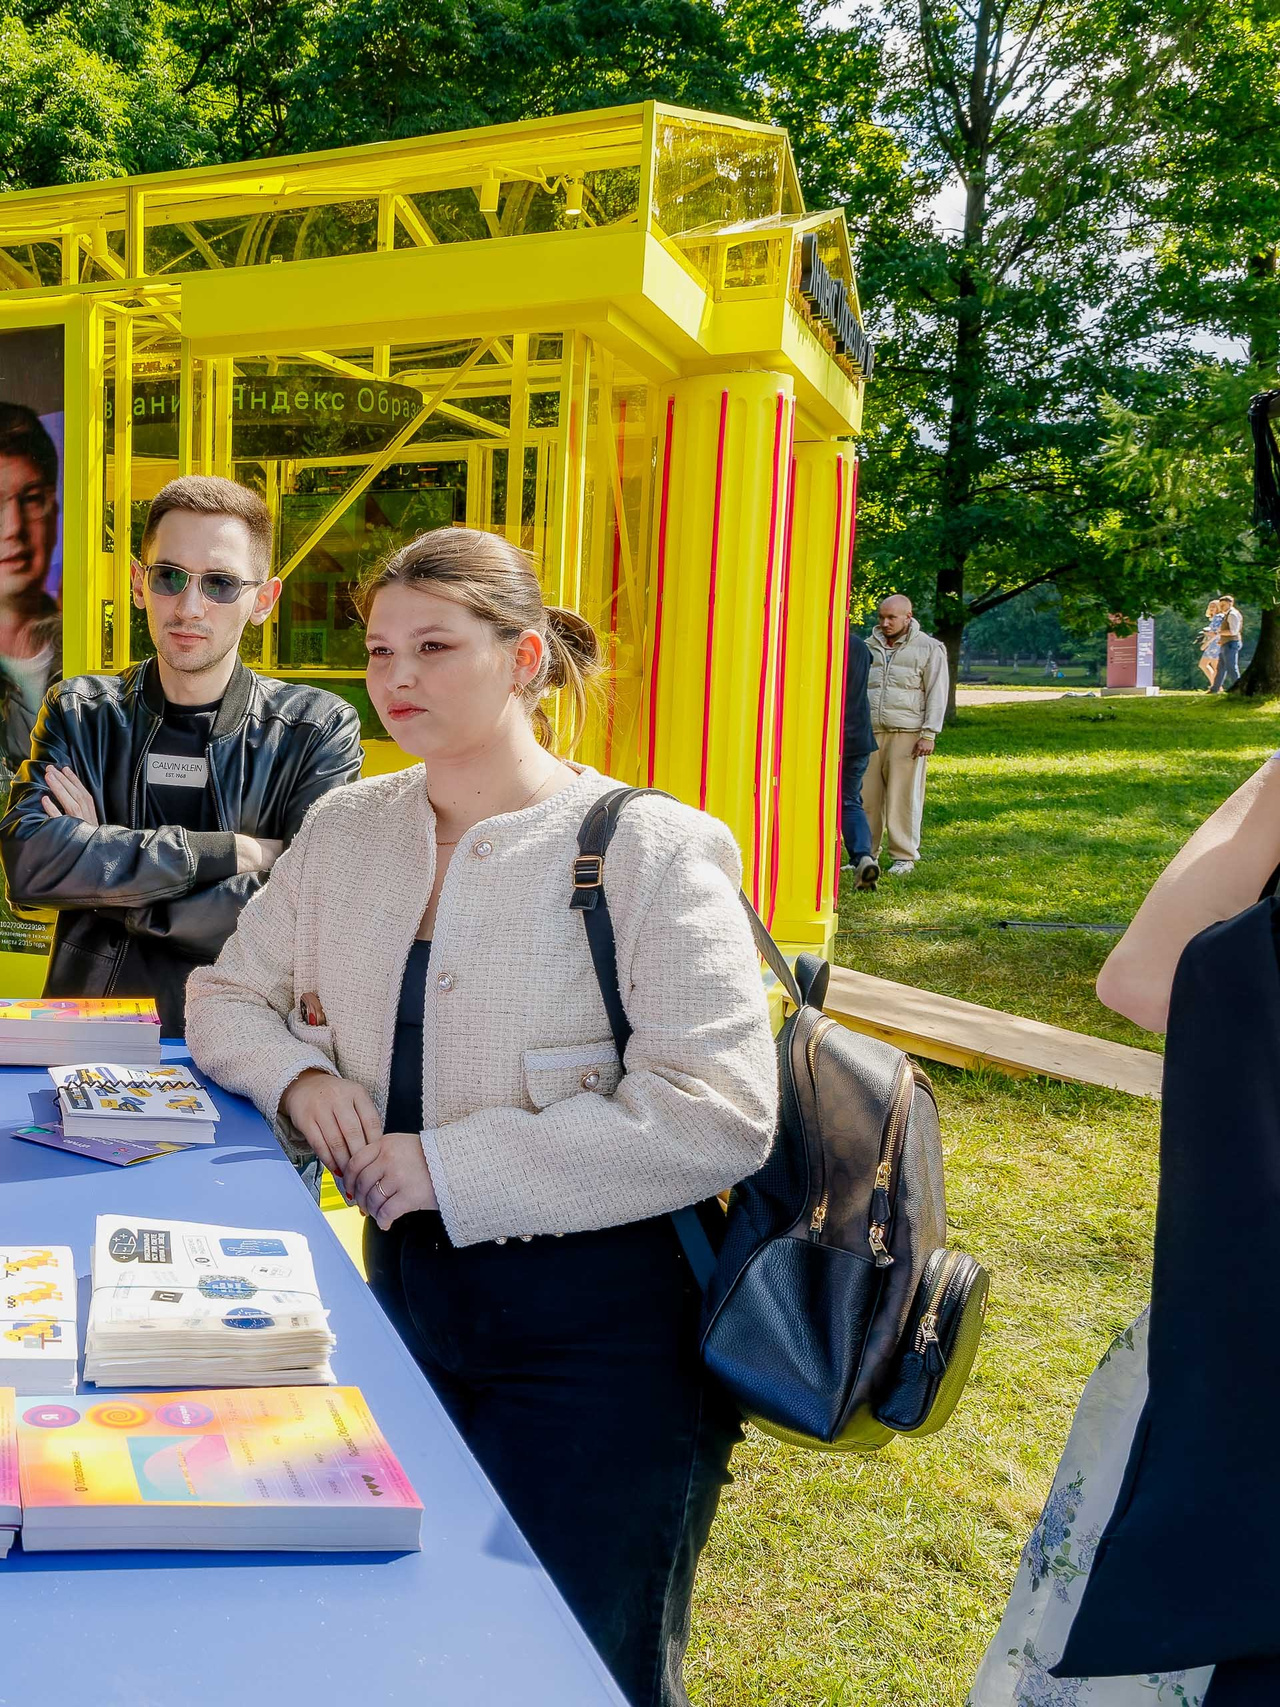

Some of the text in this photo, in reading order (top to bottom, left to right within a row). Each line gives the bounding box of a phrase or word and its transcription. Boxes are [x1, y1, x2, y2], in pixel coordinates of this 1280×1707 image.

[151, 761, 203, 772] CALVIN KLEIN
[40, 1413, 60, 1421] Я
[325, 1398, 361, 1458] Яндекс Образование
